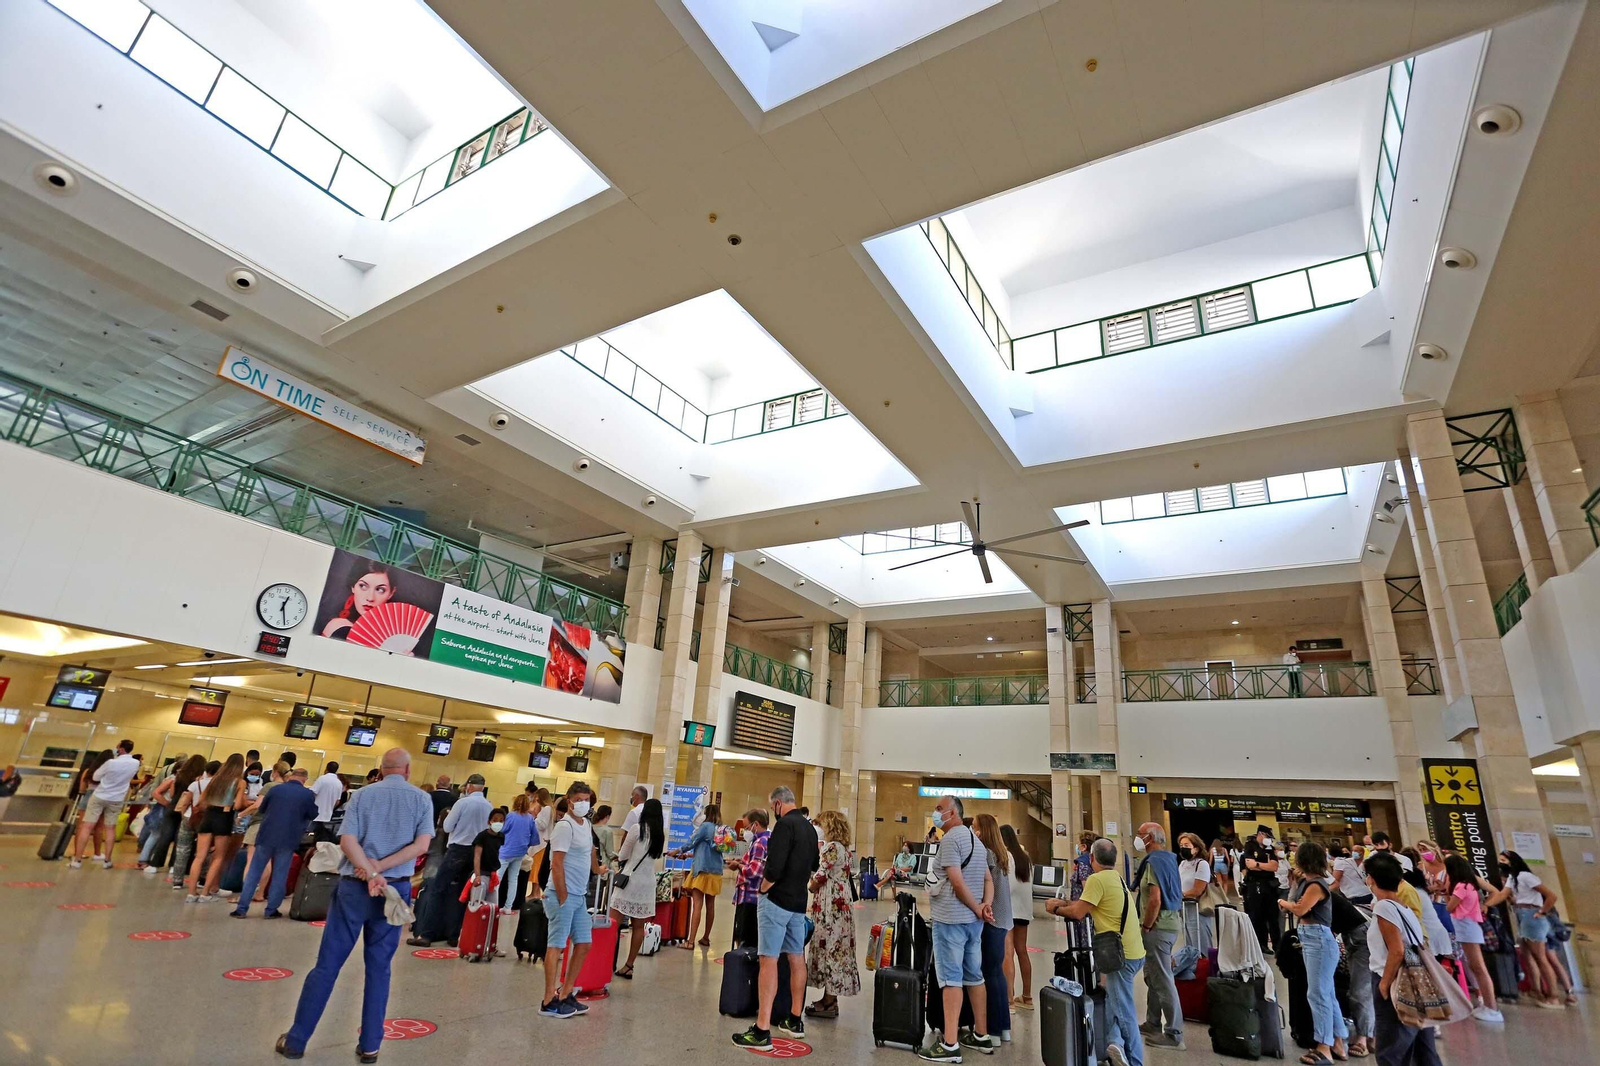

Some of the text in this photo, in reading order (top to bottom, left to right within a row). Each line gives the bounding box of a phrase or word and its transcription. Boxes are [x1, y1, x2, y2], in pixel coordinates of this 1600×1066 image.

[231, 357, 269, 390] ON
[276, 378, 326, 416] TIME
[451, 597, 544, 633] A taste of Andalusia
[453, 613, 466, 623] the
[496, 627, 514, 636] start
[514, 632, 527, 641] with
[528, 634, 546, 646] Jerez
[498, 660, 514, 670] Jerez
[72, 671, 95, 684] 12
[200, 691, 217, 703] 13
[301, 707, 316, 718] 14
[360, 716, 374, 727] 15
[436, 728, 449, 737] 16
[481, 735, 491, 744] 17
[539, 744, 548, 752] 18
[575, 749, 584, 757] 19
[929, 788, 976, 798] RYANAIR
[1275, 801, 1282, 810] 1
[1285, 801, 1292, 810] 7
[1462, 812, 1484, 843] point
[1449, 812, 1468, 860] uentro
